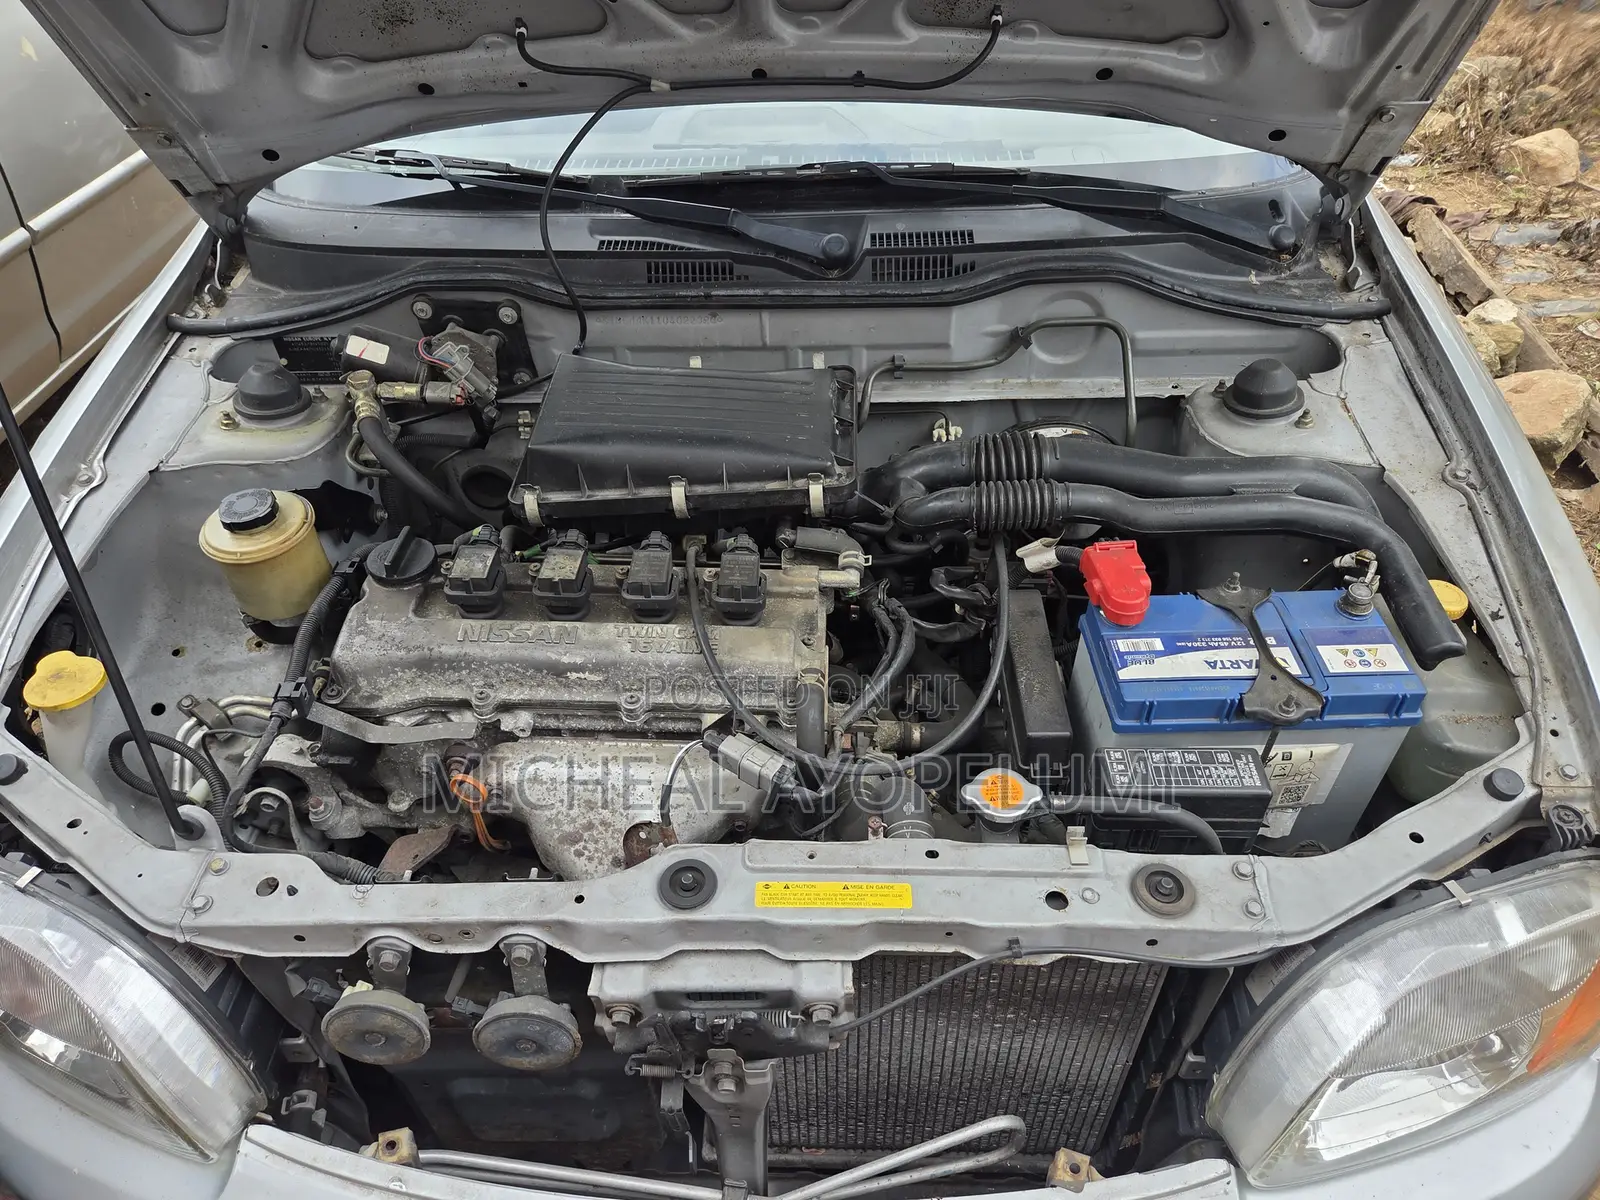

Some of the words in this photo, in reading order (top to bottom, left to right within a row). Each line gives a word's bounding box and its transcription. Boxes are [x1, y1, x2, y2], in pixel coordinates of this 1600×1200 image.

[457, 623, 579, 645] NISSAN
[614, 624, 668, 639] TWIN
[1203, 659, 1259, 669] ARTA
